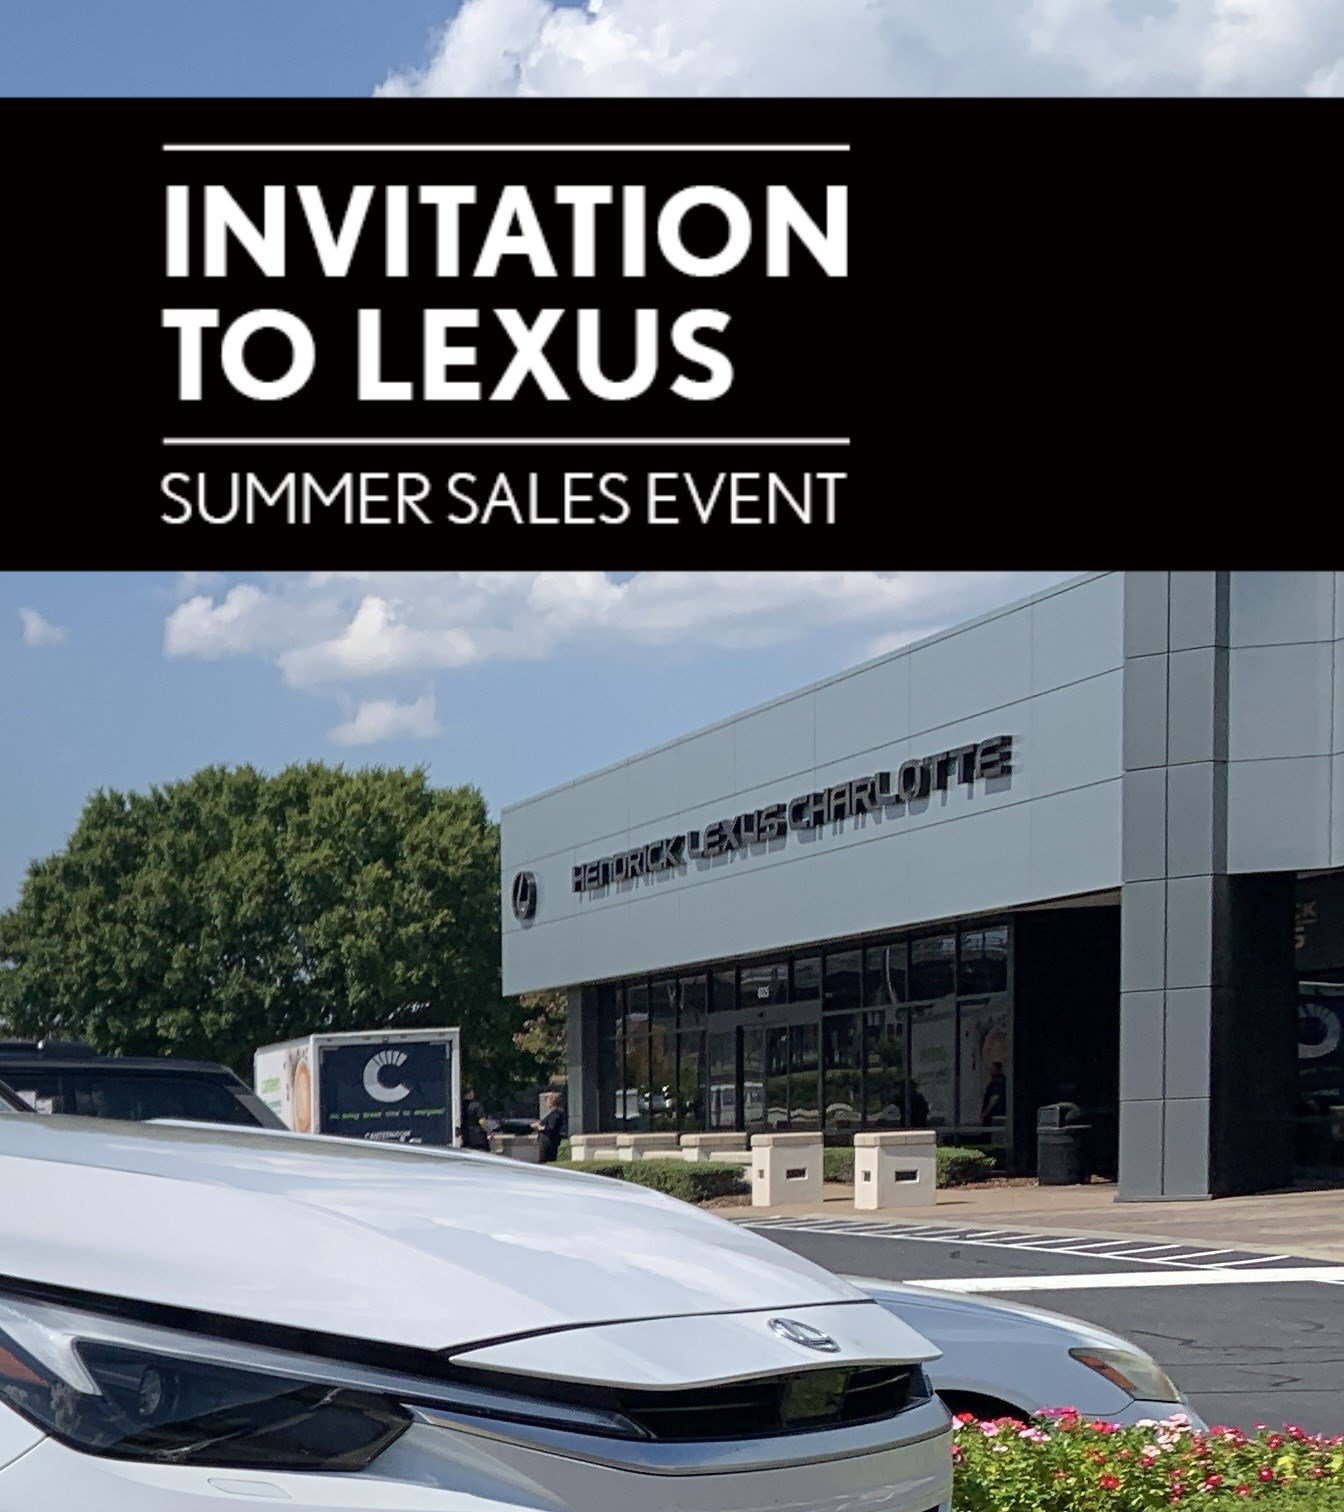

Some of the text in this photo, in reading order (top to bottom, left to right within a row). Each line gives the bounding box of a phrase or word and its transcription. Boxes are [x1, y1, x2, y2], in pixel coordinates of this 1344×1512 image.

[571, 735, 1014, 893] HENDRICK LEXUS CHARLOTTE
